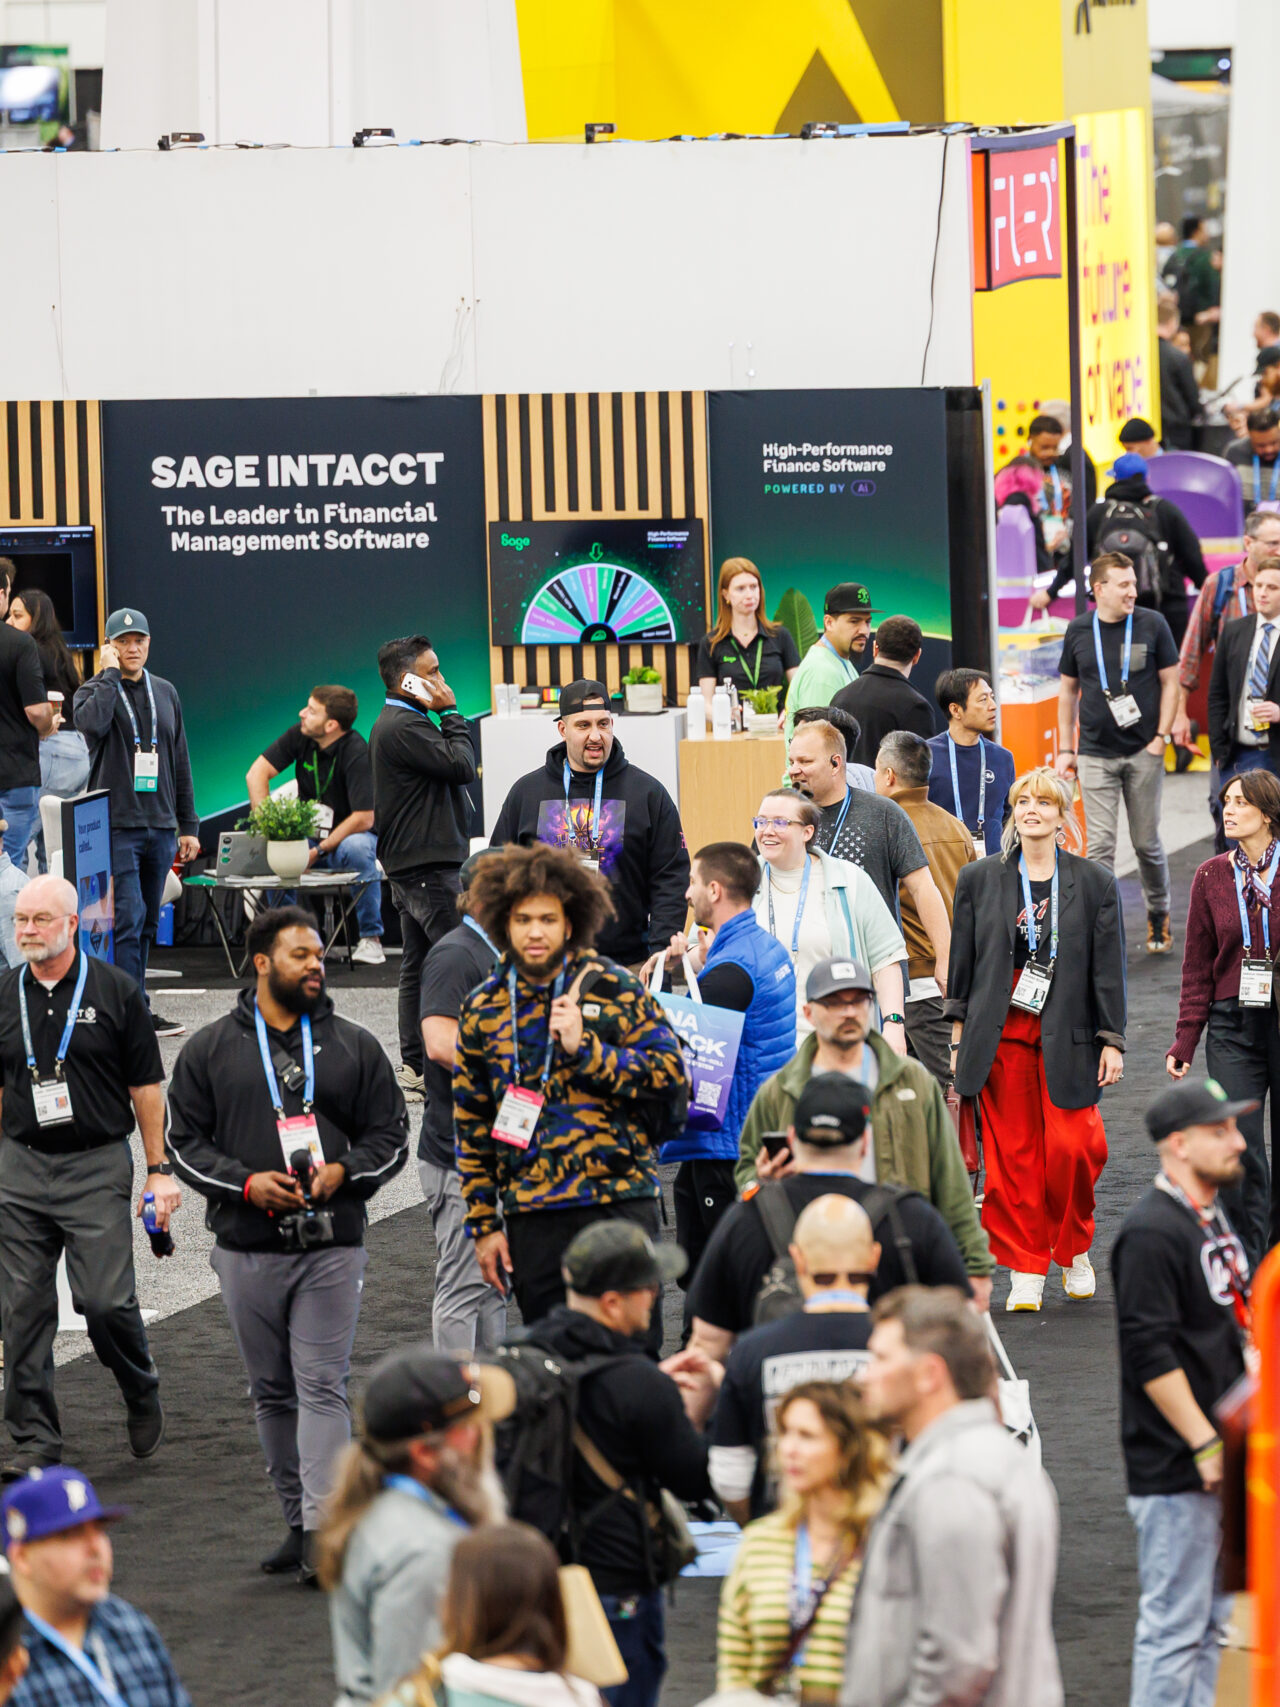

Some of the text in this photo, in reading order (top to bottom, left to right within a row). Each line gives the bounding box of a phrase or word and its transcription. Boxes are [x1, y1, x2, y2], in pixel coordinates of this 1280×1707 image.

[1075, 144, 1112, 225] The
[1083, 240, 1132, 327] future
[1086, 336, 1144, 426] of vape
[762, 442, 893, 459] High-Performance
[151, 452, 445, 488] SAGE INTACCT
[763, 458, 886, 473] Finance Software
[764, 483, 825, 494] POWERED
[829, 483, 846, 494] BY
[161, 501, 438, 526] The Leader in Financial
[171, 528, 430, 556] Management Software
[501, 533, 531, 551] Sage
